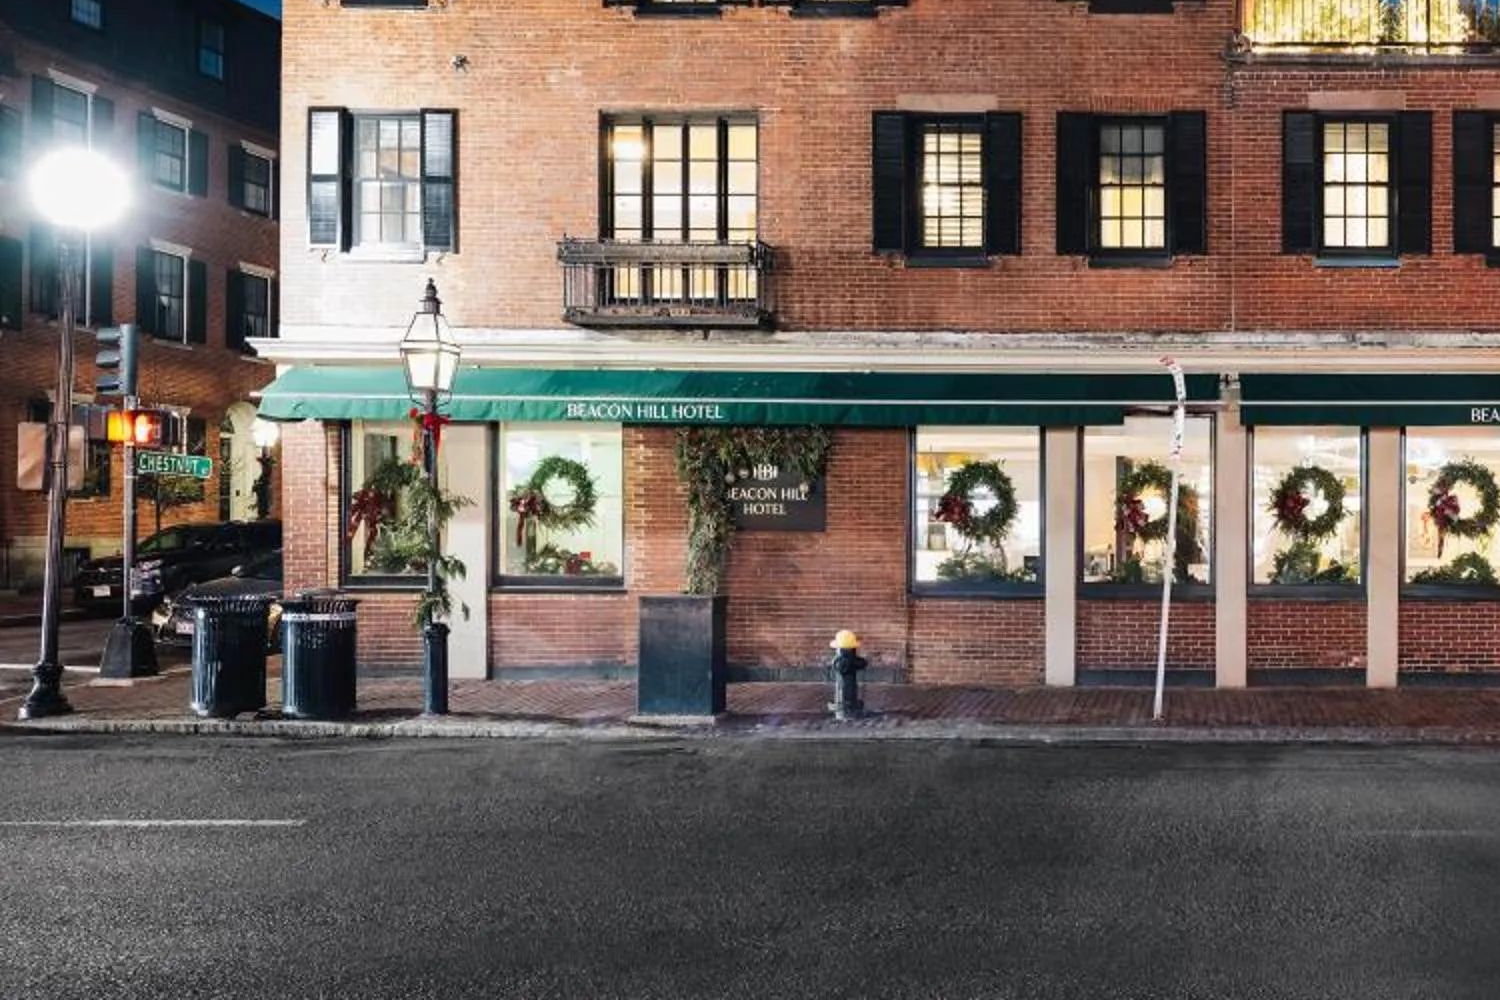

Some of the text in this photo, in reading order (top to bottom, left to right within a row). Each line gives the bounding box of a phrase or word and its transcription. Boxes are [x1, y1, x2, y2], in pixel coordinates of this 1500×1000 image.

[567, 402, 724, 419] BEACON HILL HOTEL
[139, 453, 198, 475] CHESTNUT
[743, 503, 787, 516] HOTEL
